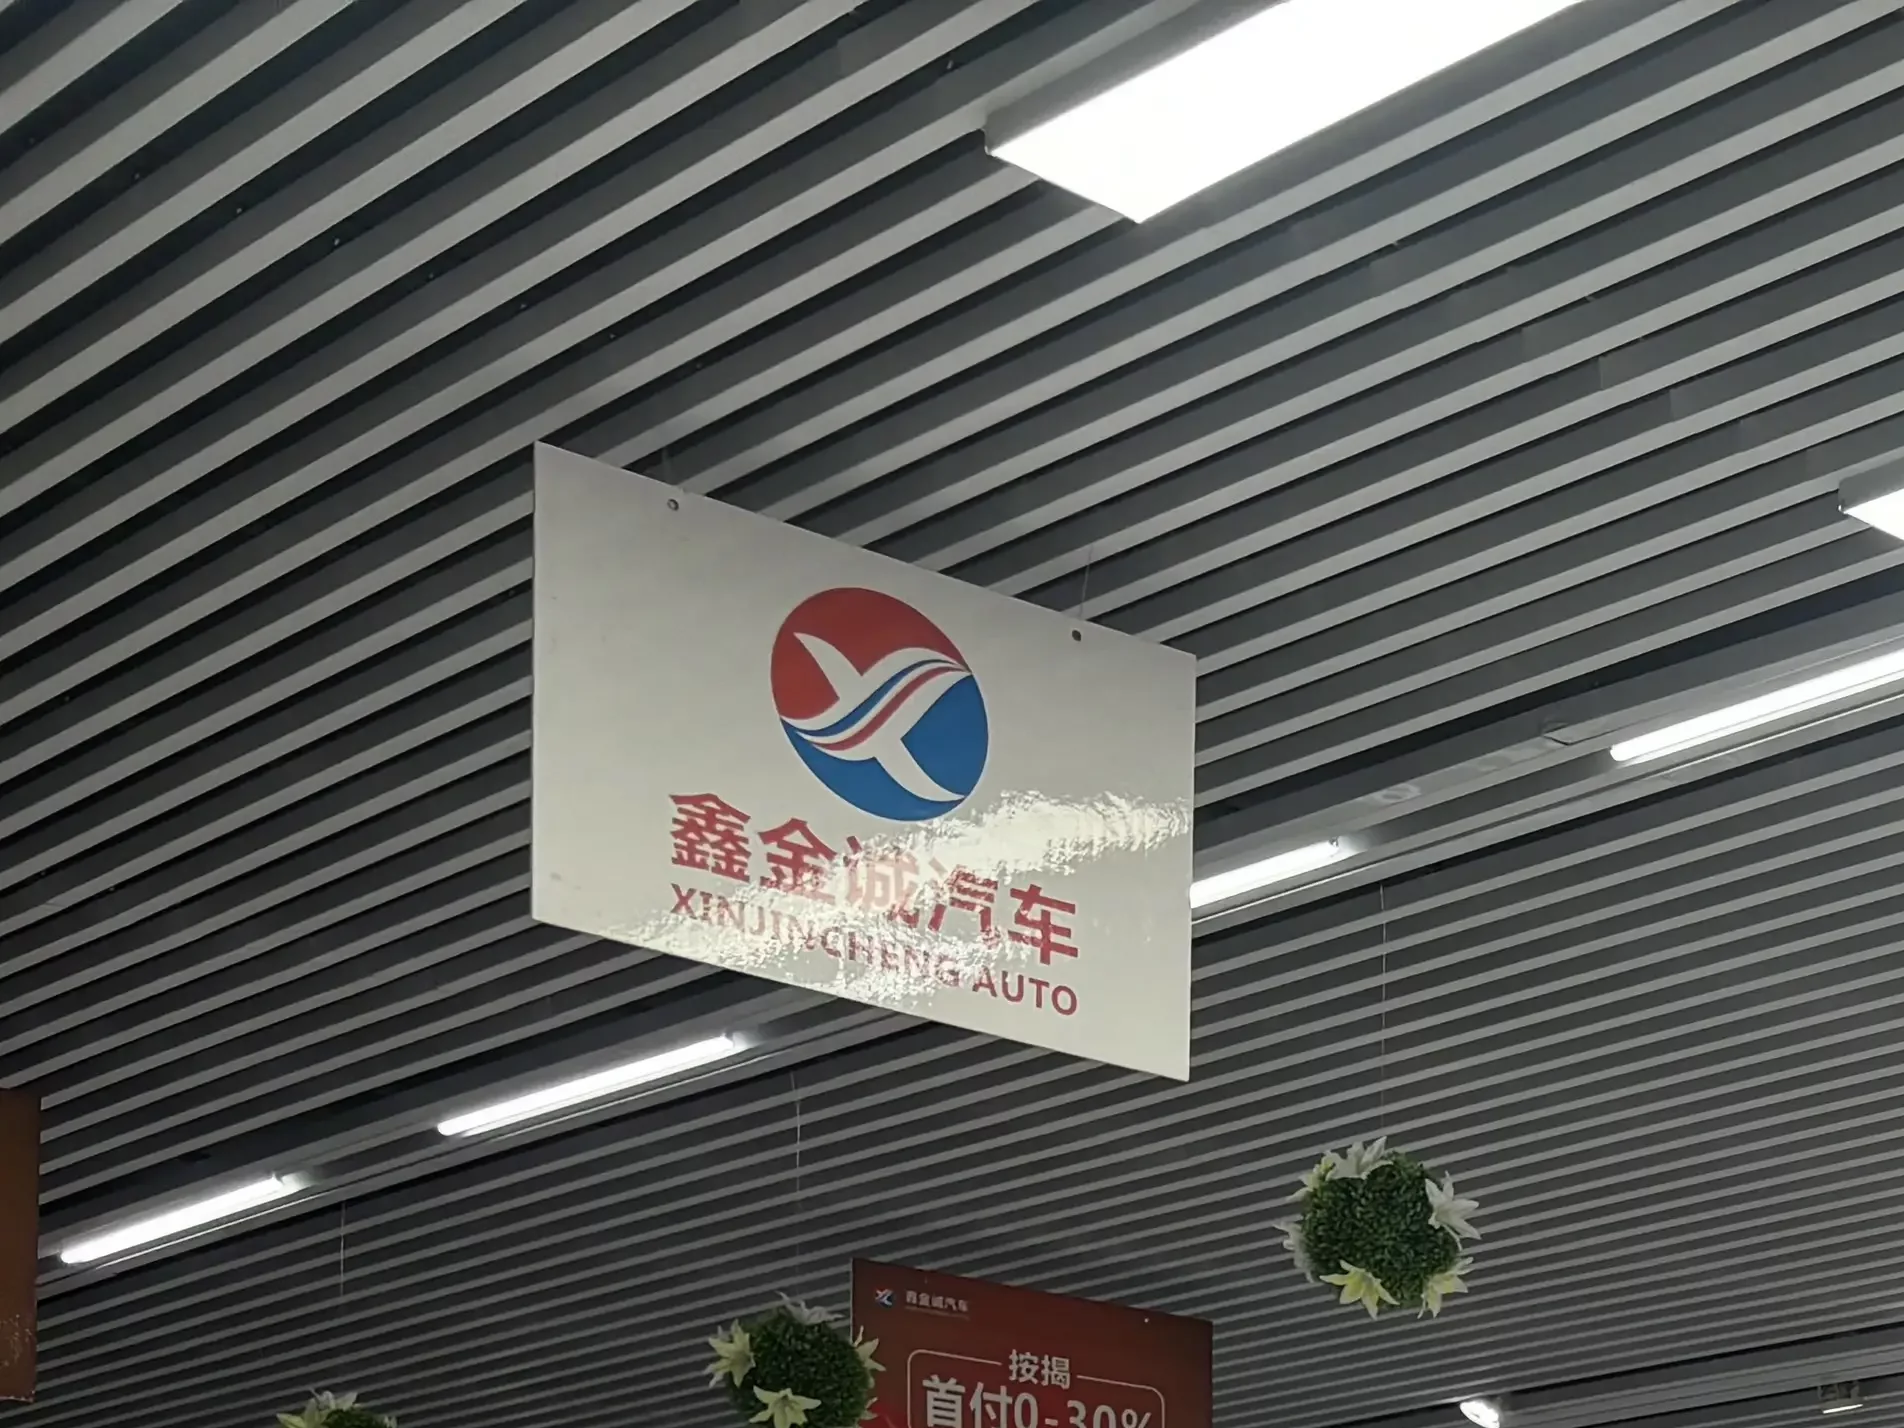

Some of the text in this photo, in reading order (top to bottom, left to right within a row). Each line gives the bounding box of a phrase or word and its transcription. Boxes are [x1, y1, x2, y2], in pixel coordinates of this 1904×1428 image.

[669, 792, 1079, 965] 鑫金诚汽车
[670, 884, 1078, 1016] XINJINCHENG AUTO
[1008, 1349, 1072, 1390] 按揭
